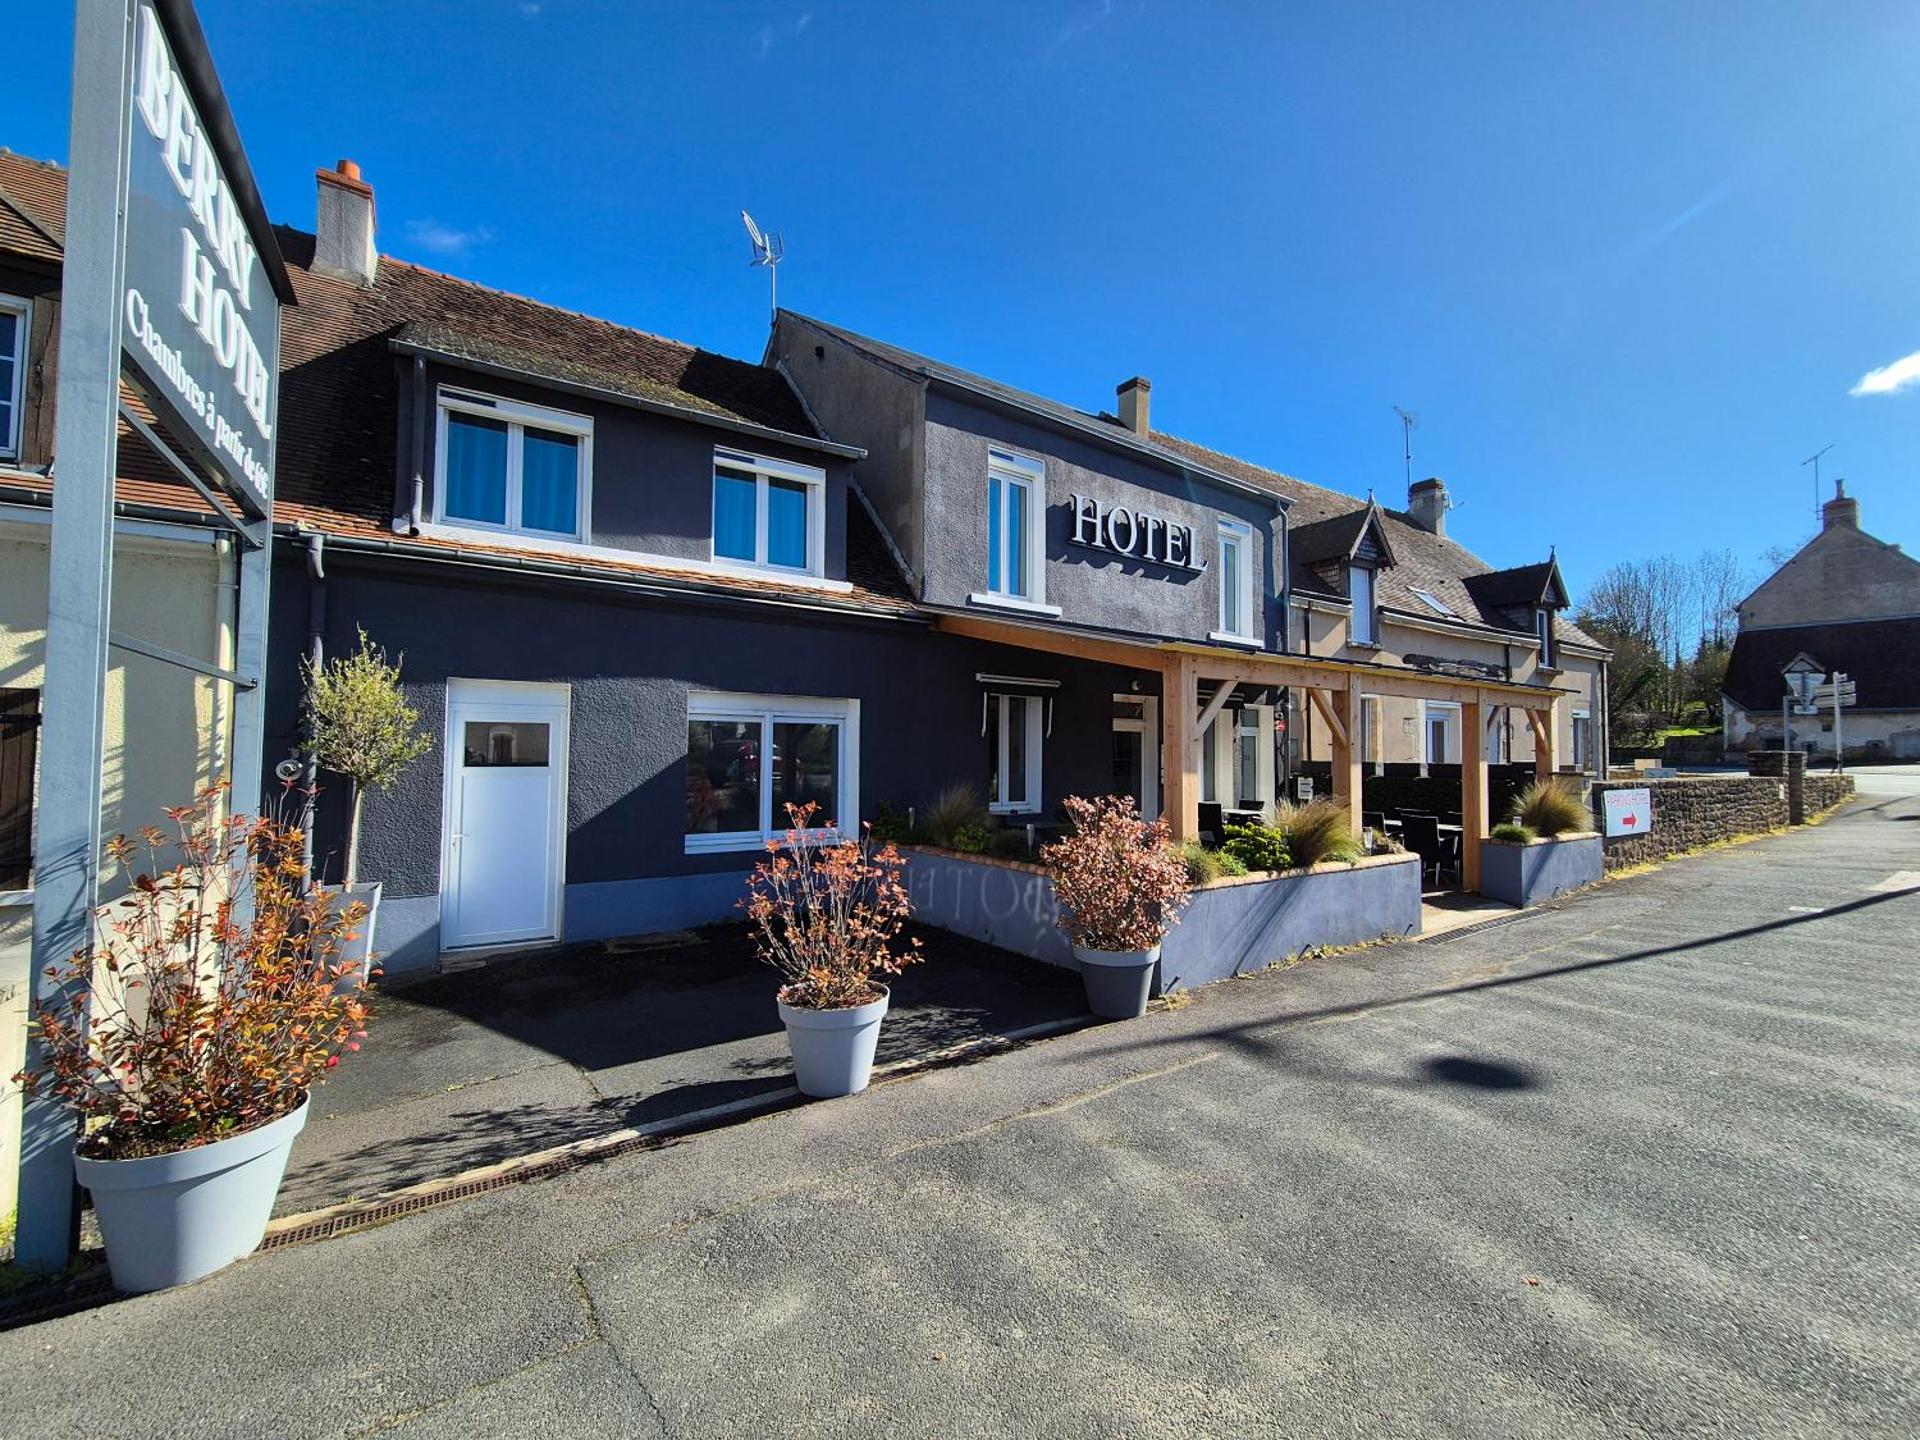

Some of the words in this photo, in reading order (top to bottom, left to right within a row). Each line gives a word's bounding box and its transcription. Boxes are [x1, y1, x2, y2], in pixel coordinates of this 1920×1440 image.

[136, 4, 256, 310] BERRY
[126, 288, 206, 417] Chambres
[205, 391, 215, 430] à
[214, 415, 246, 468] partir
[178, 227, 271, 439] HOTEL
[1070, 492, 1208, 573] HOTEL
